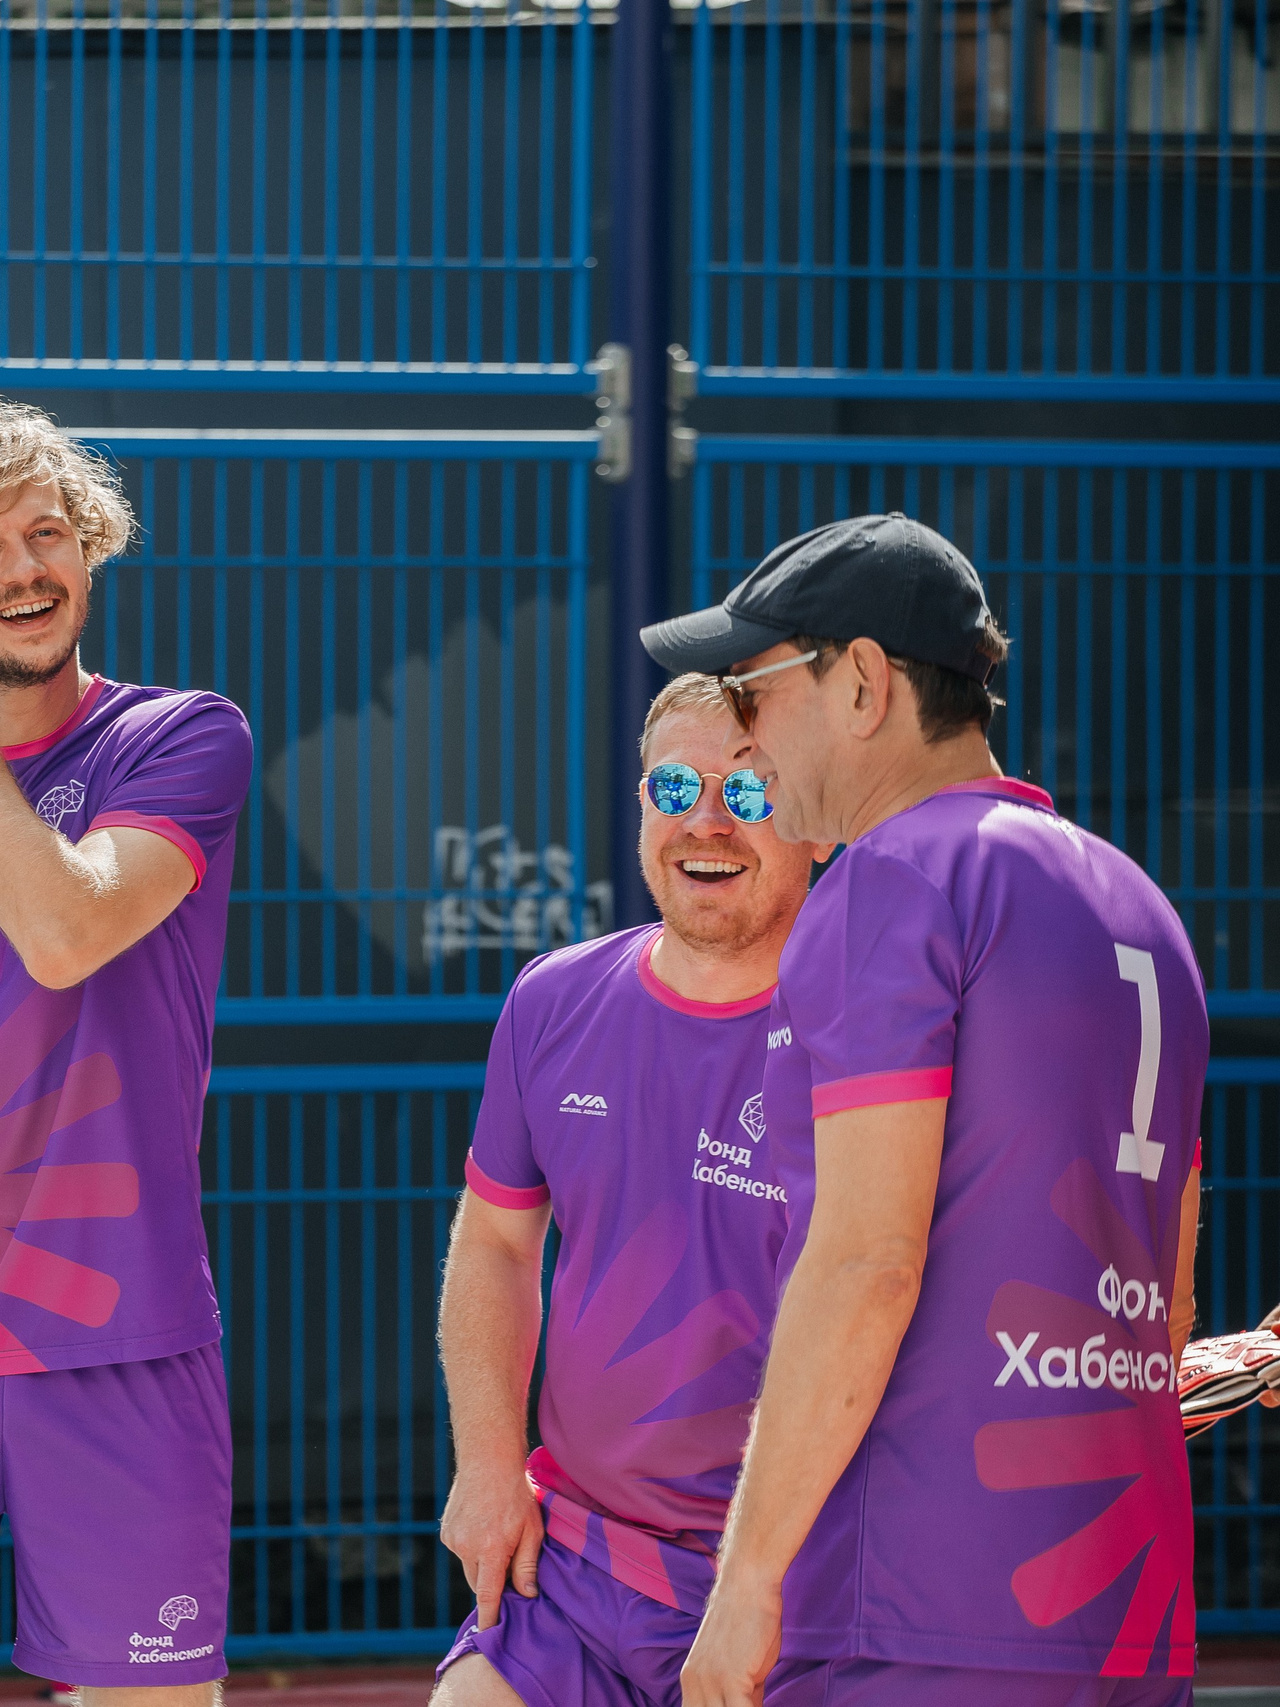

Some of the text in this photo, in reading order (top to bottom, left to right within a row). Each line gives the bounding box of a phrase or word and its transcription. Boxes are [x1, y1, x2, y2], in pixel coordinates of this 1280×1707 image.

[1114, 942, 1166, 1182] 1
[128, 1632, 174, 1648] Фонд
[128, 1644, 214, 1664] Хабенского
